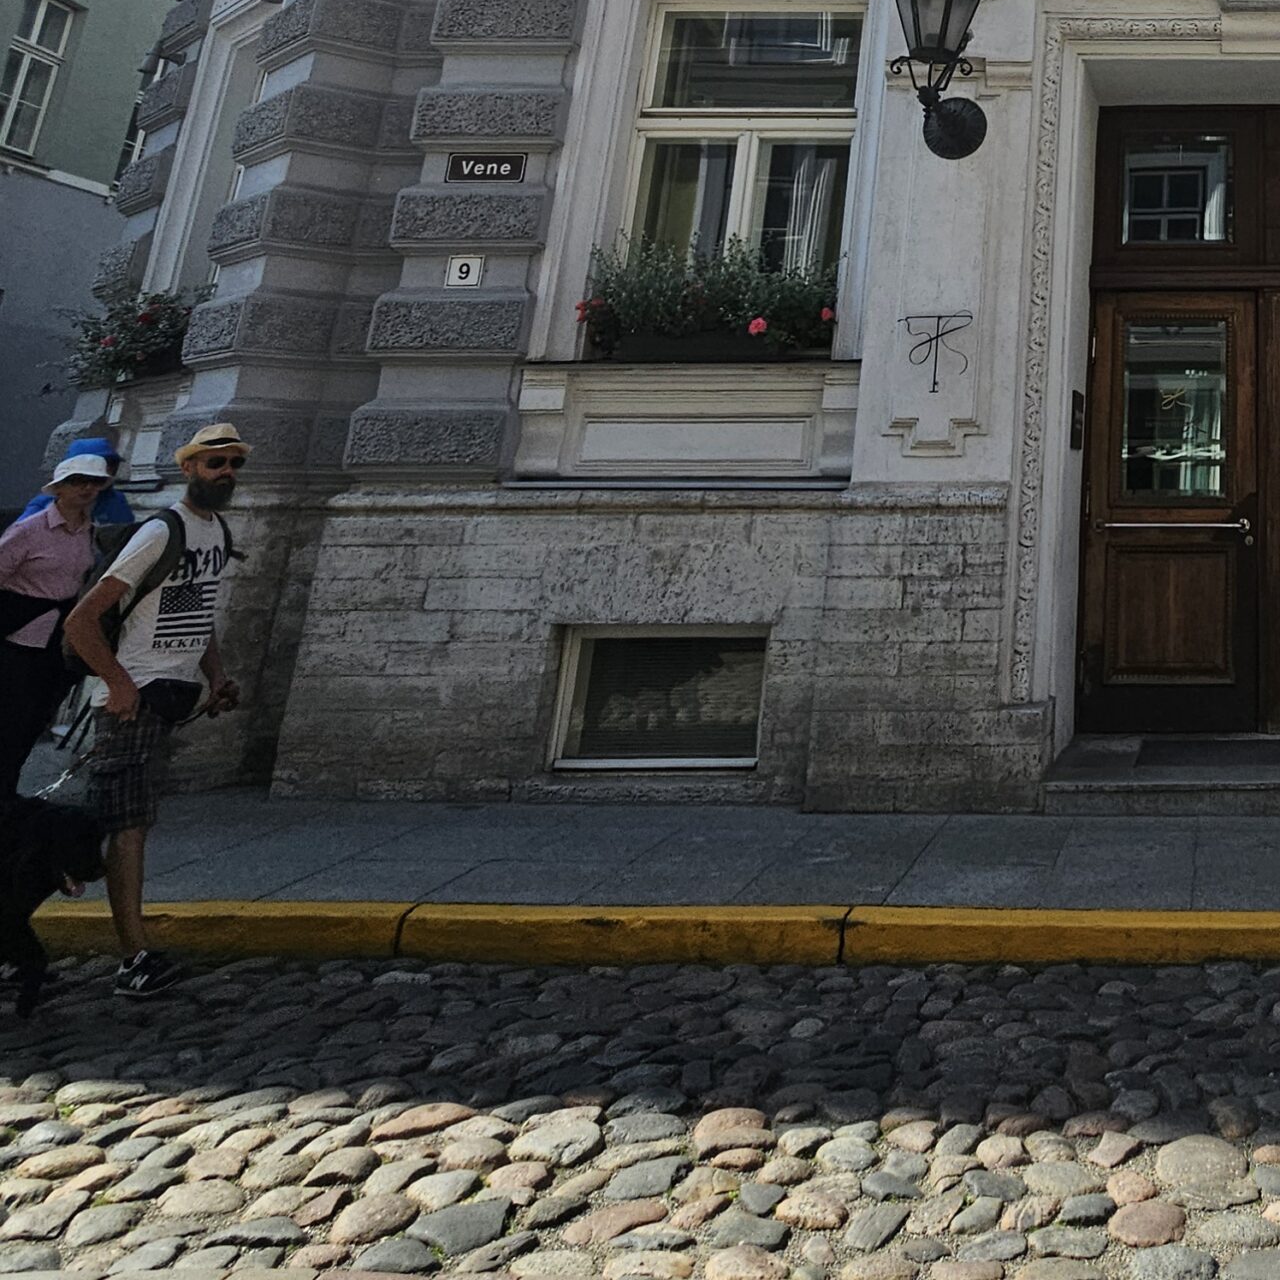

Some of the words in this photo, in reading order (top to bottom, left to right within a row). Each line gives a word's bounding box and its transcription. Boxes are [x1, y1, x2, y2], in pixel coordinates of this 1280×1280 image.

[462, 161, 511, 175] Vene
[458, 263, 471, 280] 9
[152, 638, 189, 649] BACK
